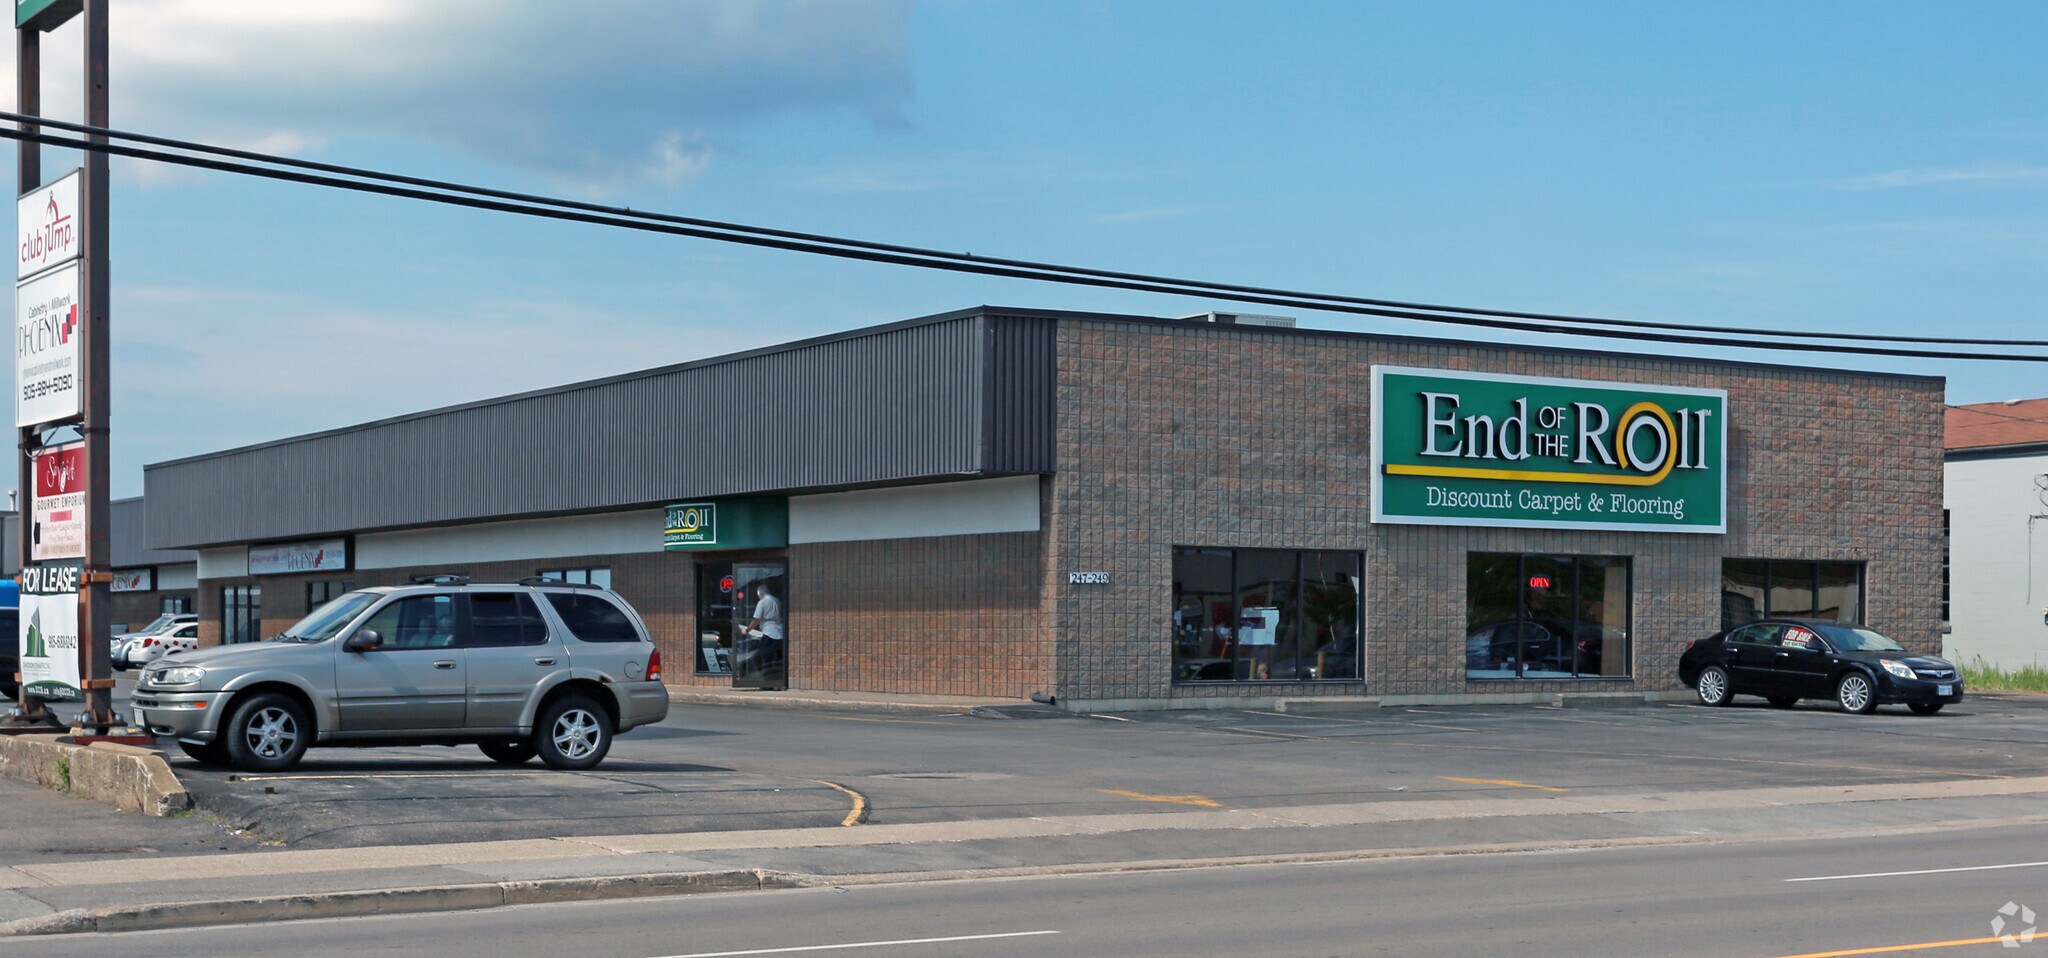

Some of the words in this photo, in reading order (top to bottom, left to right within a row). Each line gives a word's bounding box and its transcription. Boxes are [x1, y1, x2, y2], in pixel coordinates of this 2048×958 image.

[22, 229, 43, 263] club
[43, 222, 71, 263] jump
[19, 312, 62, 359] PHOENIX
[1420, 391, 1531, 461] End
[1539, 405, 1566, 429] OF
[1535, 433, 1569, 457] THE
[1573, 401, 1709, 472] Roll
[37, 498, 60, 511] GOURMET
[1426, 486, 1511, 509] Discount
[1518, 489, 1582, 515] Carpet
[1588, 493, 1604, 512] &
[1610, 493, 1684, 520] Flooring
[677, 509, 709, 528] Roll
[22, 568, 40, 592] FOR
[42, 567, 77, 592] LEASE
[1071, 573, 1109, 584] 247-249
[1530, 576, 1550, 588] OPEN
[1785, 629, 1798, 640] FOR
[1796, 631, 1813, 643] SALE
